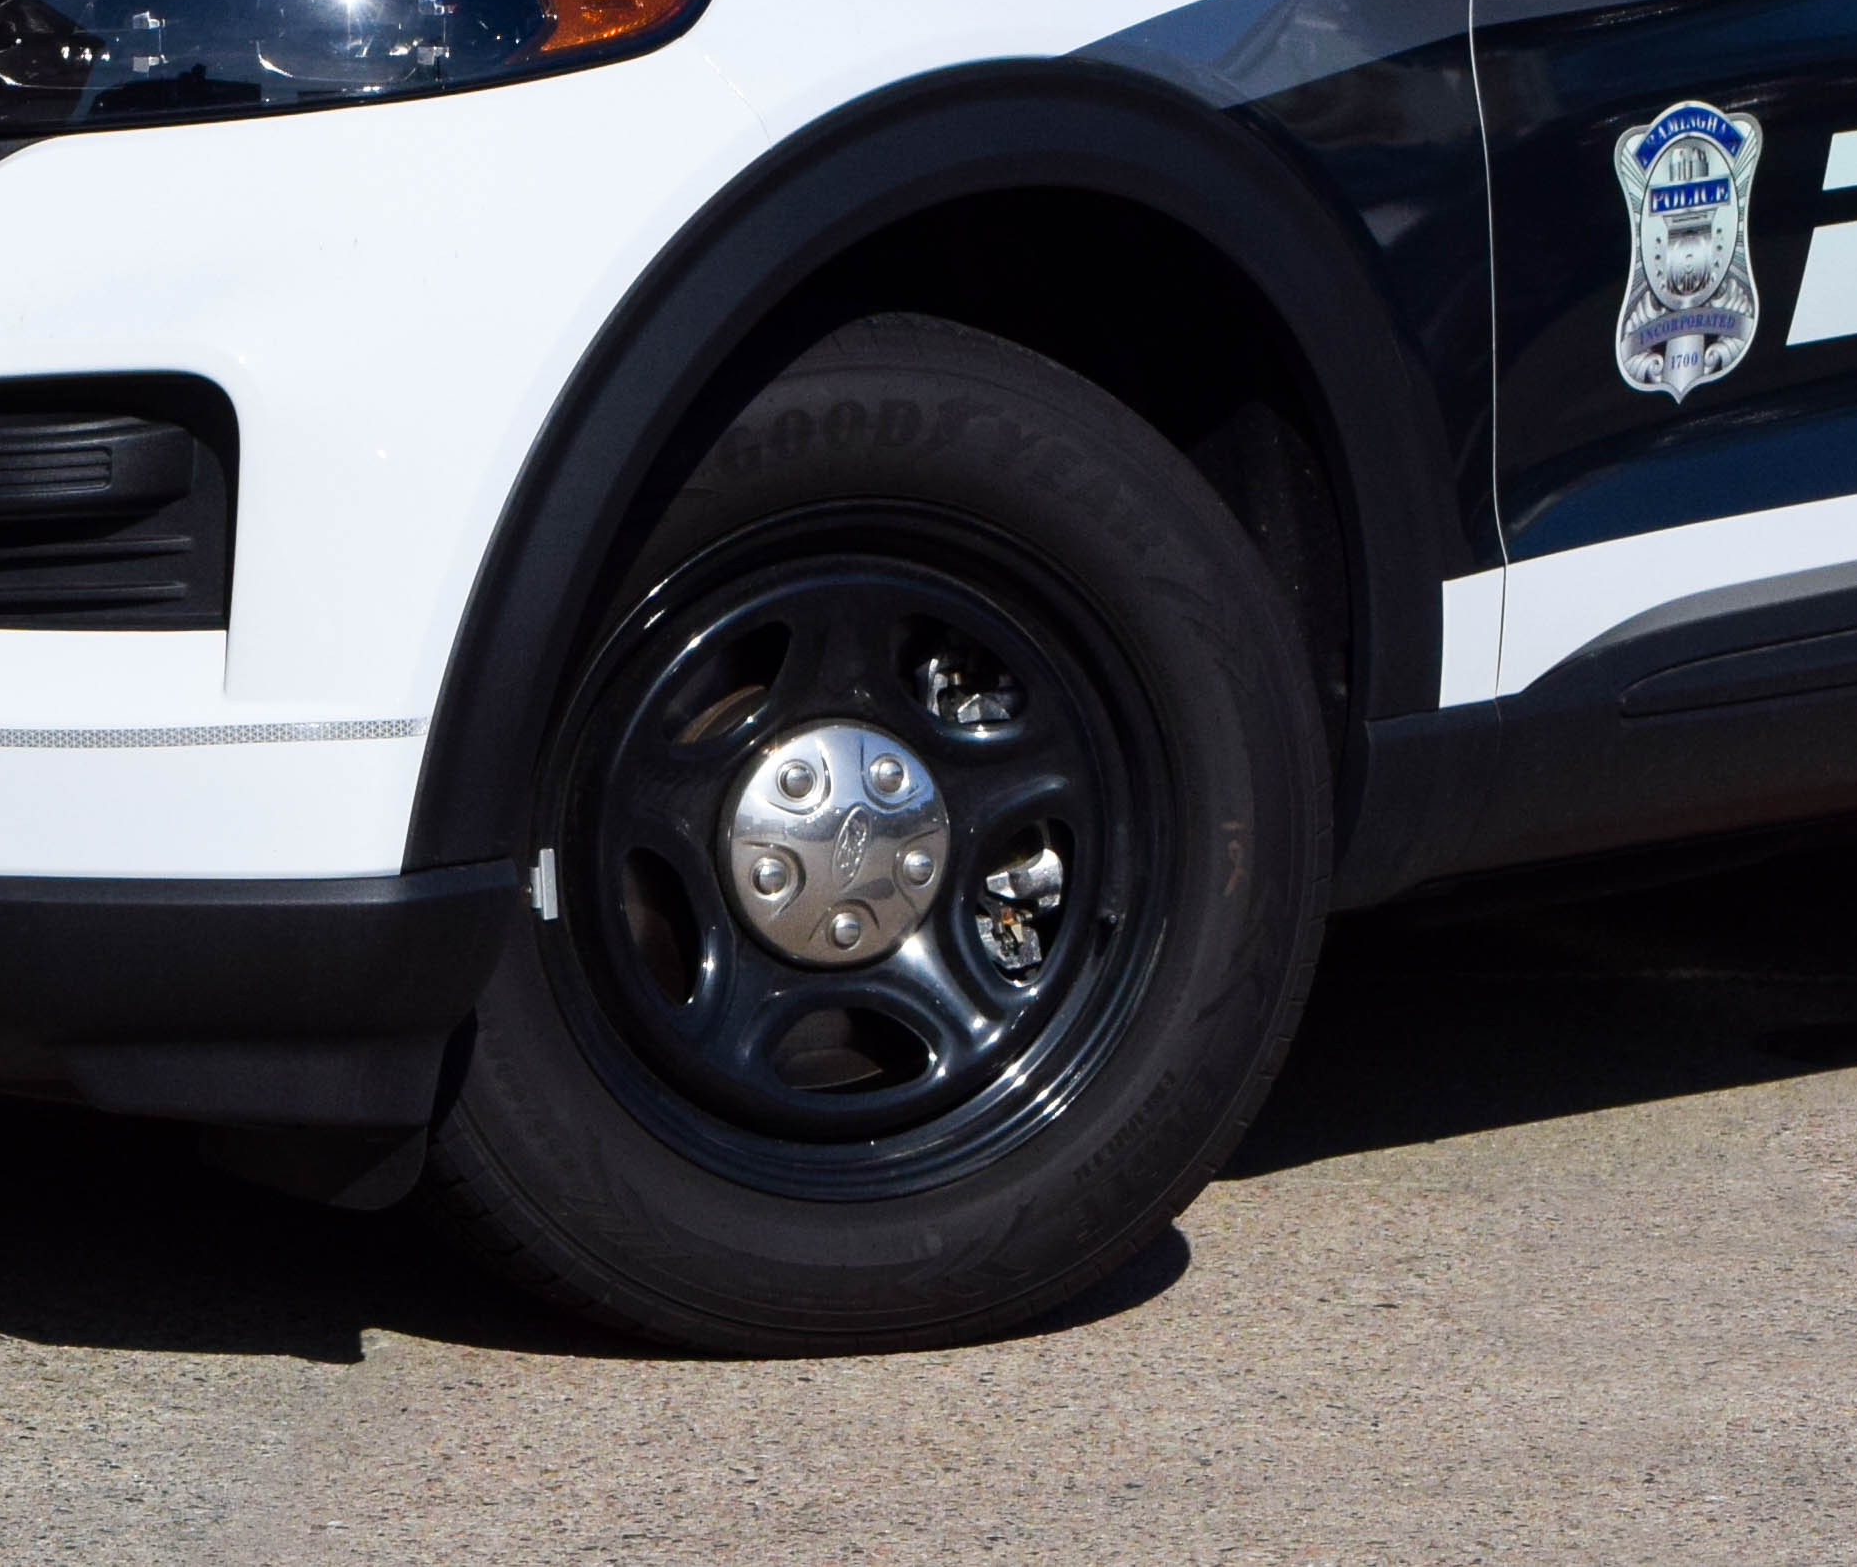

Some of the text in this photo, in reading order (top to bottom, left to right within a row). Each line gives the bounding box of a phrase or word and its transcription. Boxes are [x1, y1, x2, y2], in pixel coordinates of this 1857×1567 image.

[1651, 186, 1730, 213] POLICE
[1638, 312, 1737, 345] INCORPORATED
[1670, 351, 1699, 371] 1700
